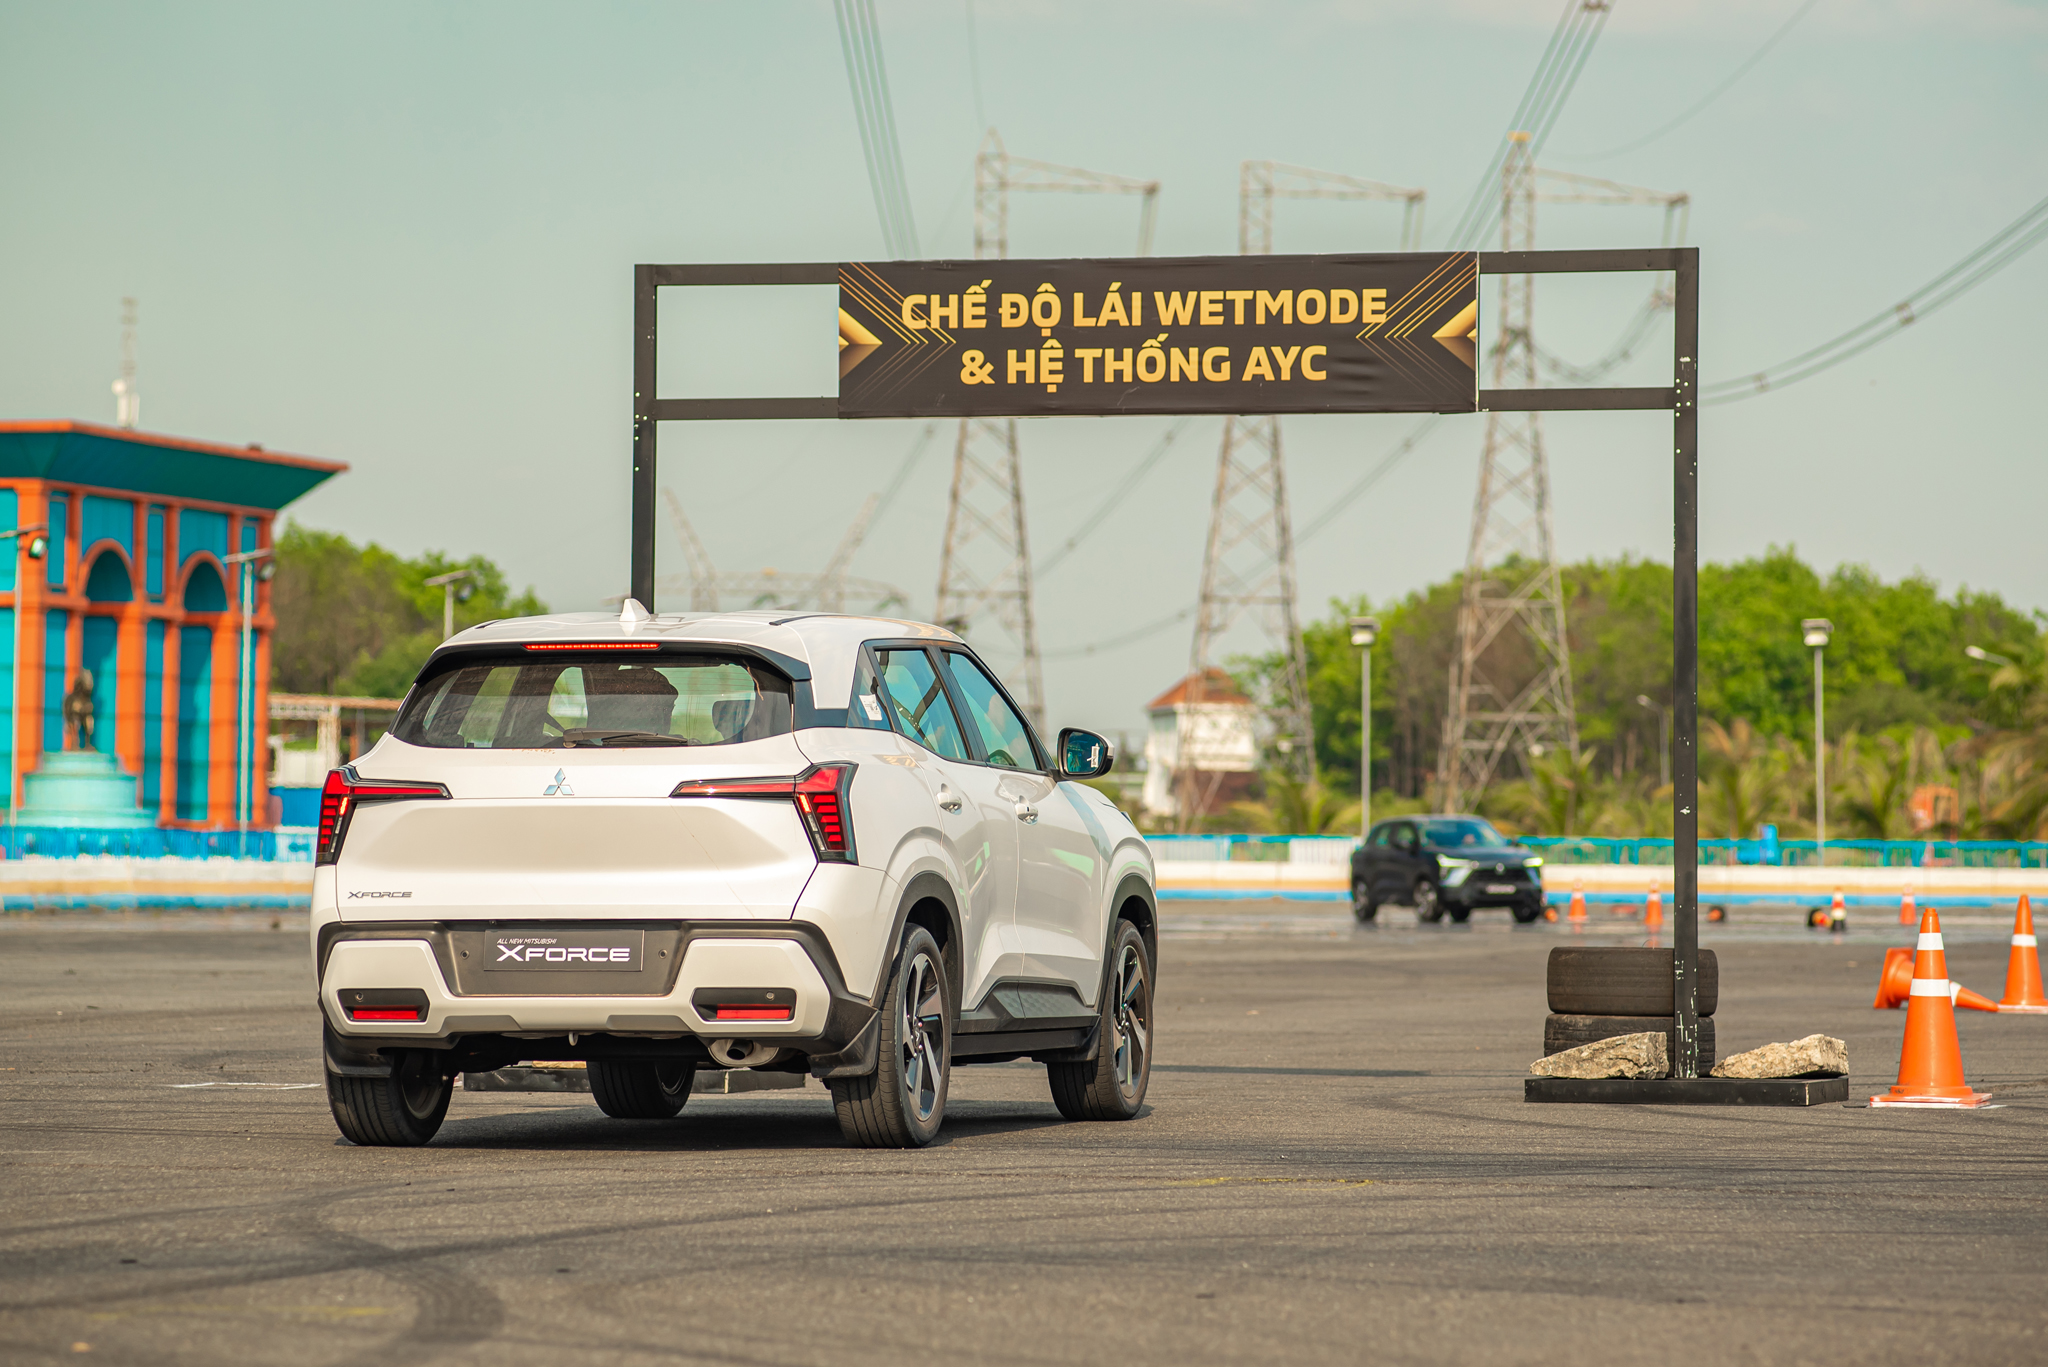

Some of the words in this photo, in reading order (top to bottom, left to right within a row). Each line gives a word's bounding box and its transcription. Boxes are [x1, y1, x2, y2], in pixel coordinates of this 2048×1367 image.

[901, 279, 993, 330] CHẾ
[998, 282, 1062, 337] ĐỘ
[1073, 281, 1143, 328] LÁI
[1153, 288, 1388, 326] WETMODE
[960, 349, 996, 386] &
[1007, 338, 1065, 394] HỆ
[1074, 333, 1232, 383] THỐNG
[1241, 345, 1328, 382] AYC
[347, 890, 413, 899] XFORCE
[496, 944, 631, 962] XFORCE
